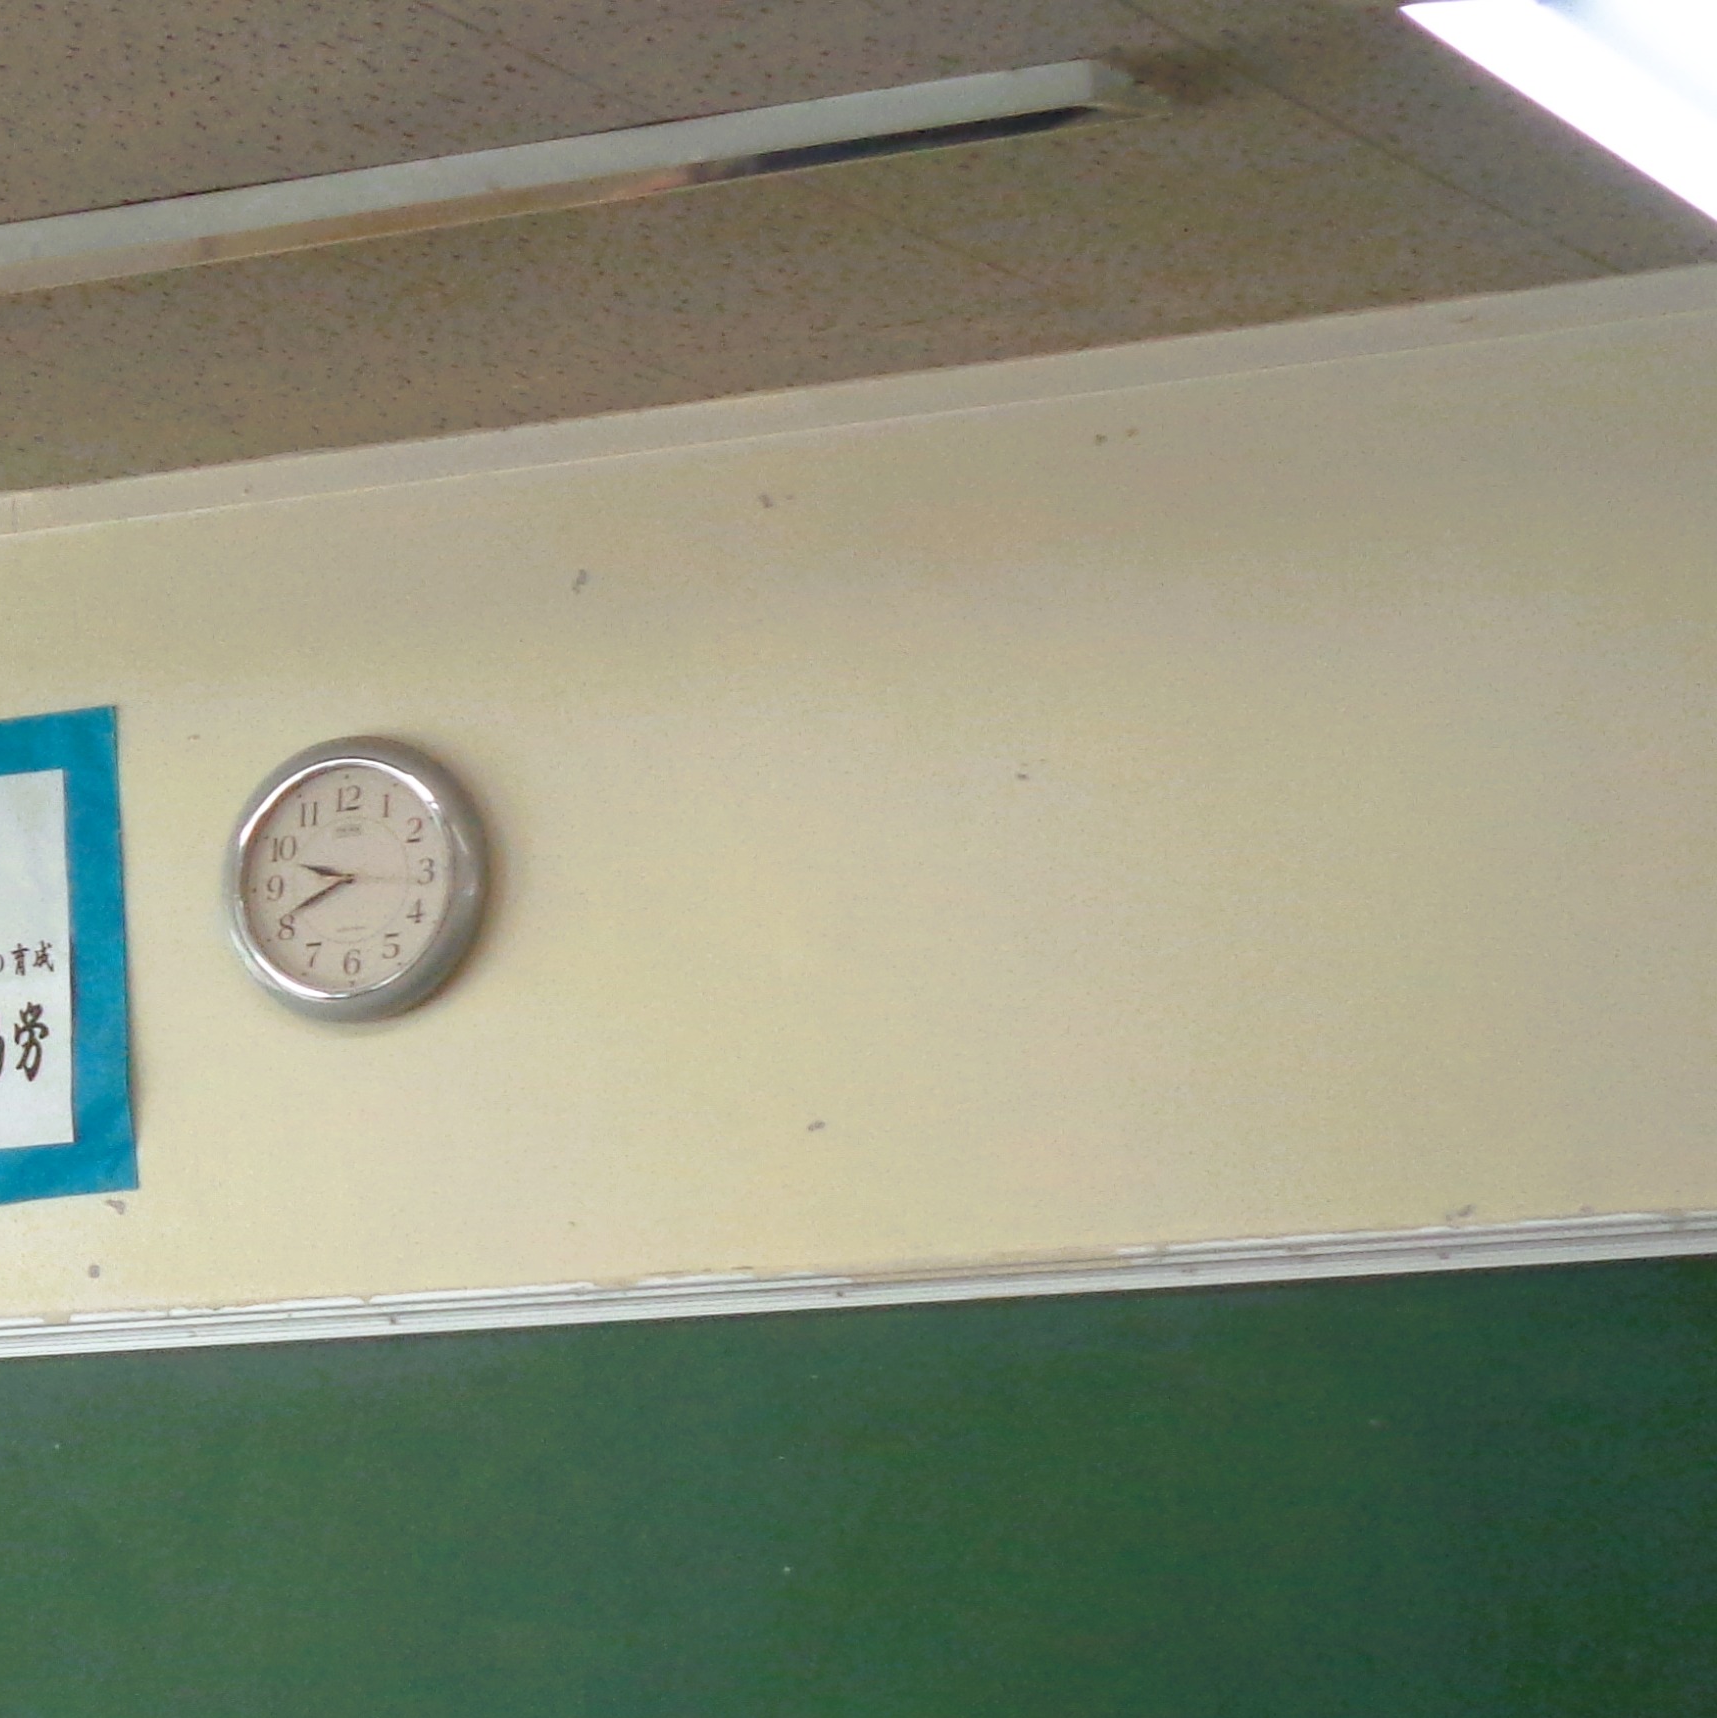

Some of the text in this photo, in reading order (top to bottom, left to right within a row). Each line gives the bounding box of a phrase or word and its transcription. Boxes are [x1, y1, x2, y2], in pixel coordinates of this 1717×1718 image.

[336, 785, 362, 812] 12
[381, 794, 390, 818] 1
[299, 801, 318, 827] 11
[406, 817, 423, 843] 2
[271, 836, 297, 863] 10
[417, 858, 434, 885] 3
[267, 875, 285, 901] 9
[406, 899, 424, 924] 4
[278, 914, 296, 940] 8
[306, 942, 322, 968] 7
[382, 933, 400, 959] 5
[343, 949, 361, 976] 6
